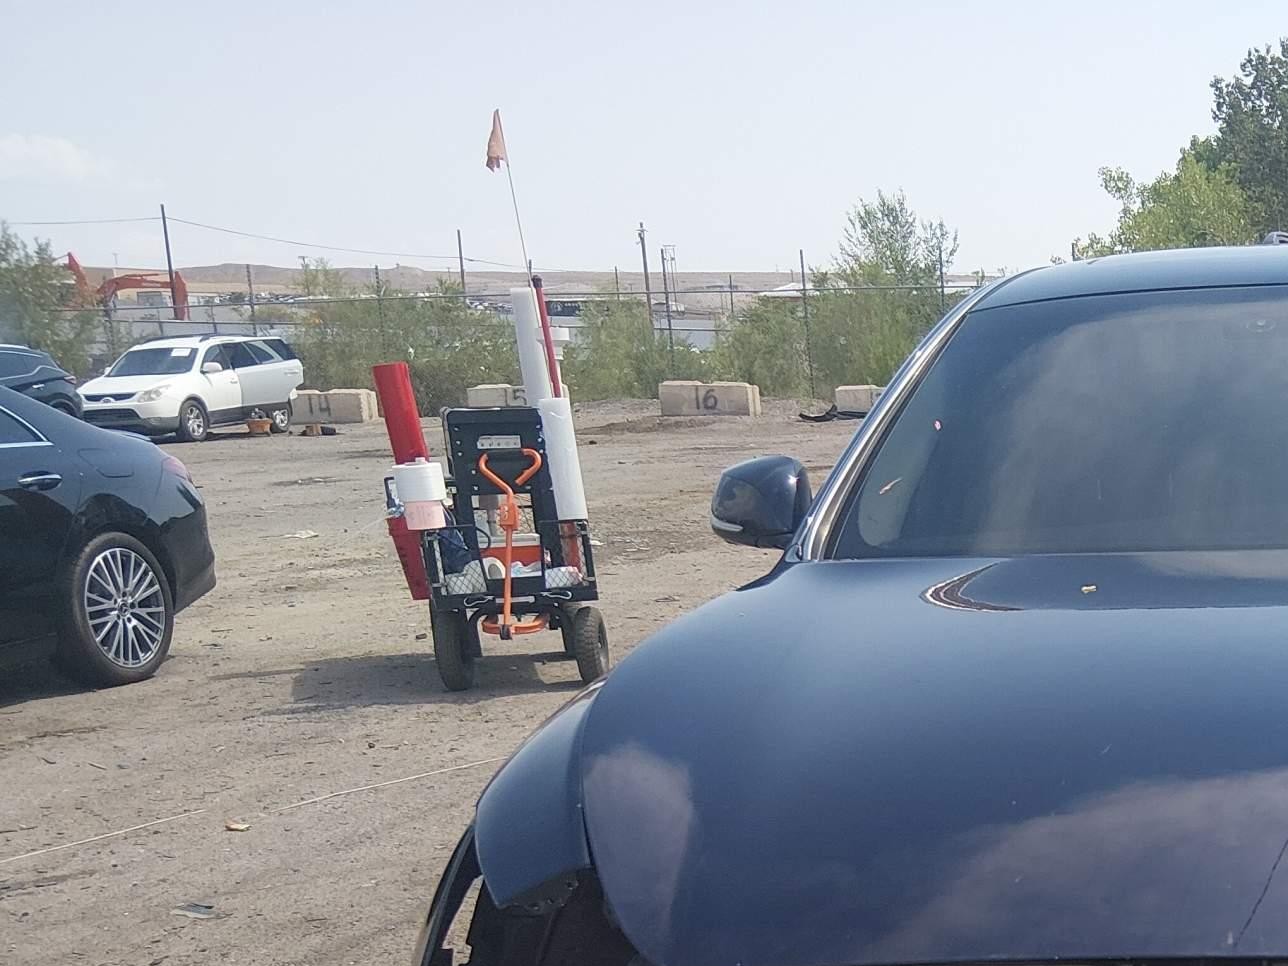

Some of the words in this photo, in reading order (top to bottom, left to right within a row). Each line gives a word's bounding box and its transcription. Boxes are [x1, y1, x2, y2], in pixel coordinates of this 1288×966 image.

[308, 394, 332, 416] 14
[503, 386, 528, 407] 15
[694, 385, 718, 410] 16
